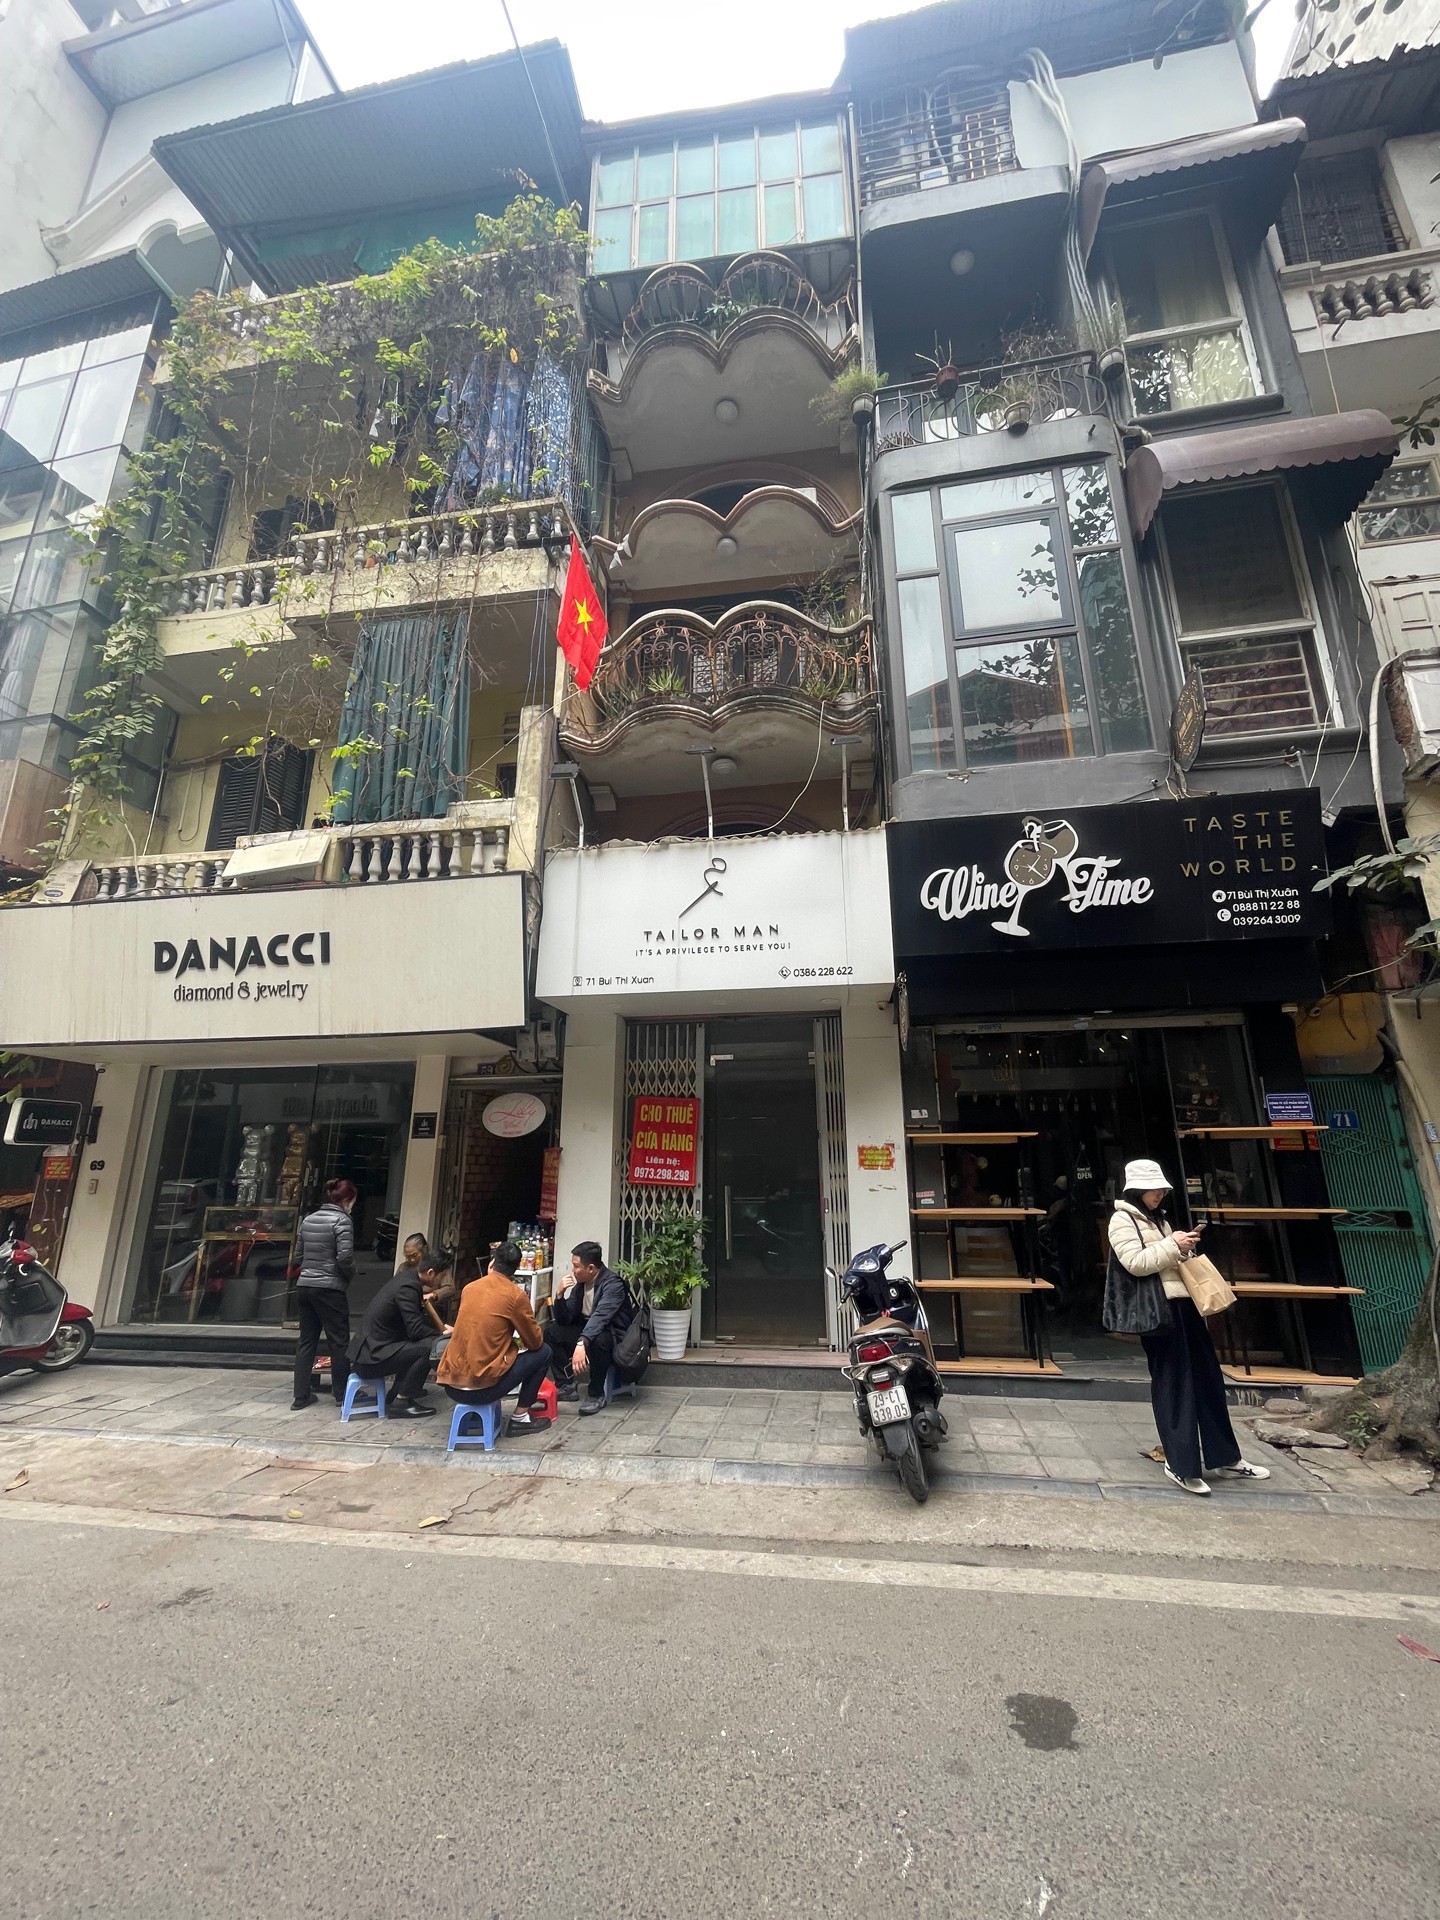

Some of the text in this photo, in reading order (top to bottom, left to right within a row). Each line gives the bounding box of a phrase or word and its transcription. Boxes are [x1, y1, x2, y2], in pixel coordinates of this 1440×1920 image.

[1183, 810, 1293, 833] TASTE
[1233, 832, 1296, 850] THE
[1179, 856, 1297, 878] WORLD
[919, 855, 1155, 921] Wine Time
[1226, 888, 1299, 900] 71 Bùi Thị Xuân
[1232, 903, 1259, 912] 0888
[643, 923, 780, 943] TAILOR MAN
[153, 931, 331, 979] DANACCI
[635, 949, 653, 957] IT'S
[665, 946, 715, 956] PRIVILEGE
[718, 945, 731, 953] TO
[734, 943, 764, 952] SERVE
[793, 966, 854, 978] 0386 228 622
[585, 975, 655, 986] 71 Bui Thi Xuan
[173, 980, 309, 1002] diamond & jewelry
[640, 1103, 694, 1124] CHO THUÊ
[1332, 1113, 1352, 1127] 71
[40, 1118, 73, 1127] DANACCI
[635, 1126, 694, 1152] CỬA HÀNG
[89, 1160, 105, 1171] 69
[645, 1156, 681, 1167] Liên hệ:
[633, 1166, 690, 1181] 0973.298.298
[872, 1389, 902, 1409] 29-C1
